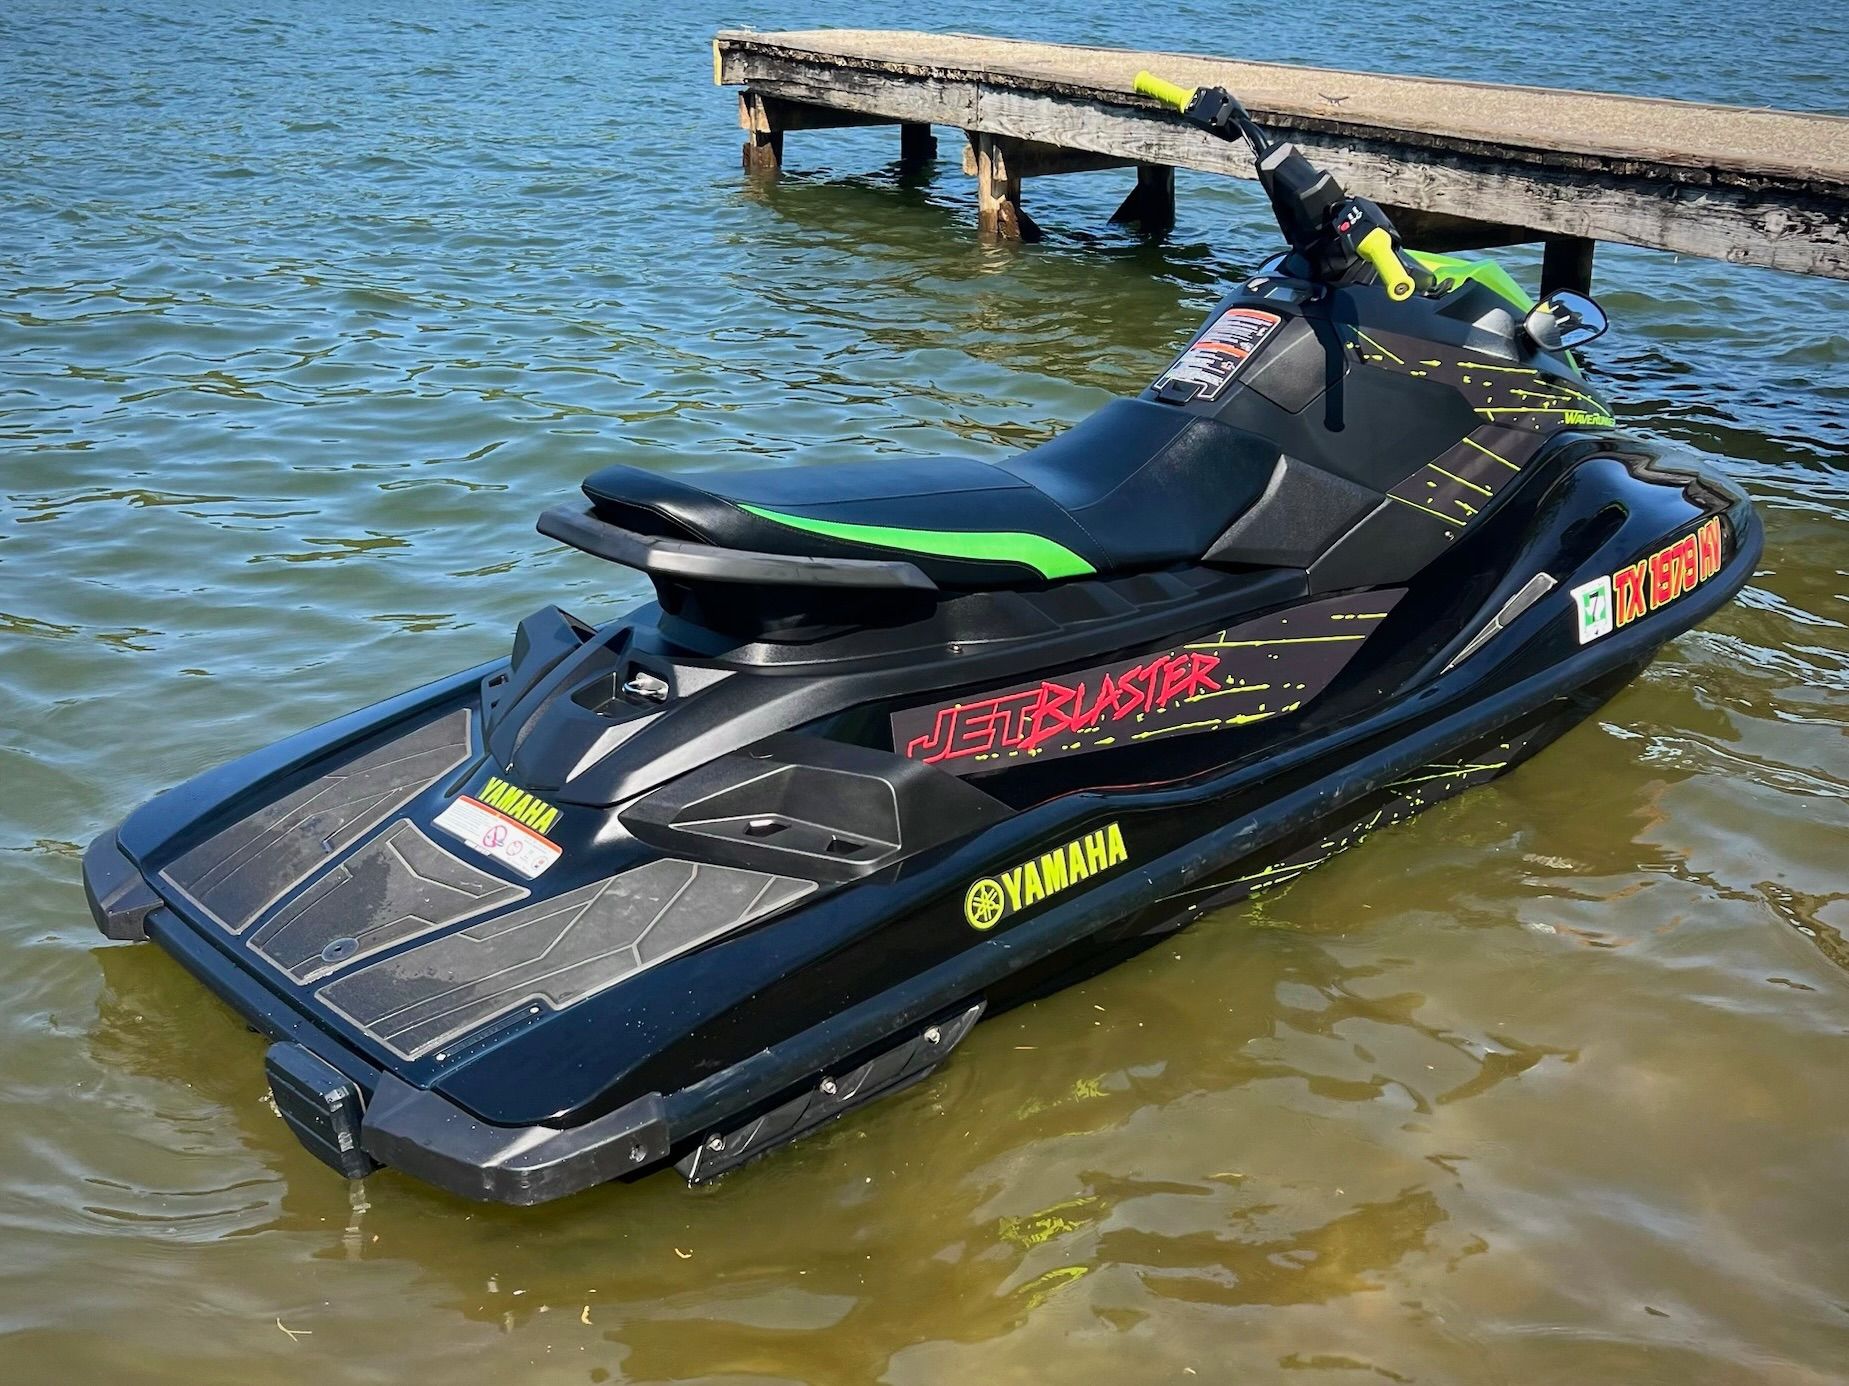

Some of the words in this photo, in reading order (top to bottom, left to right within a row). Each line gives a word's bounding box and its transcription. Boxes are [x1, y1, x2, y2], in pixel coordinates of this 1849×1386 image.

[1613, 559, 1647, 627] TX
[477, 776, 559, 835] YAMAHA
[1001, 822, 1128, 912] YAMAHA
